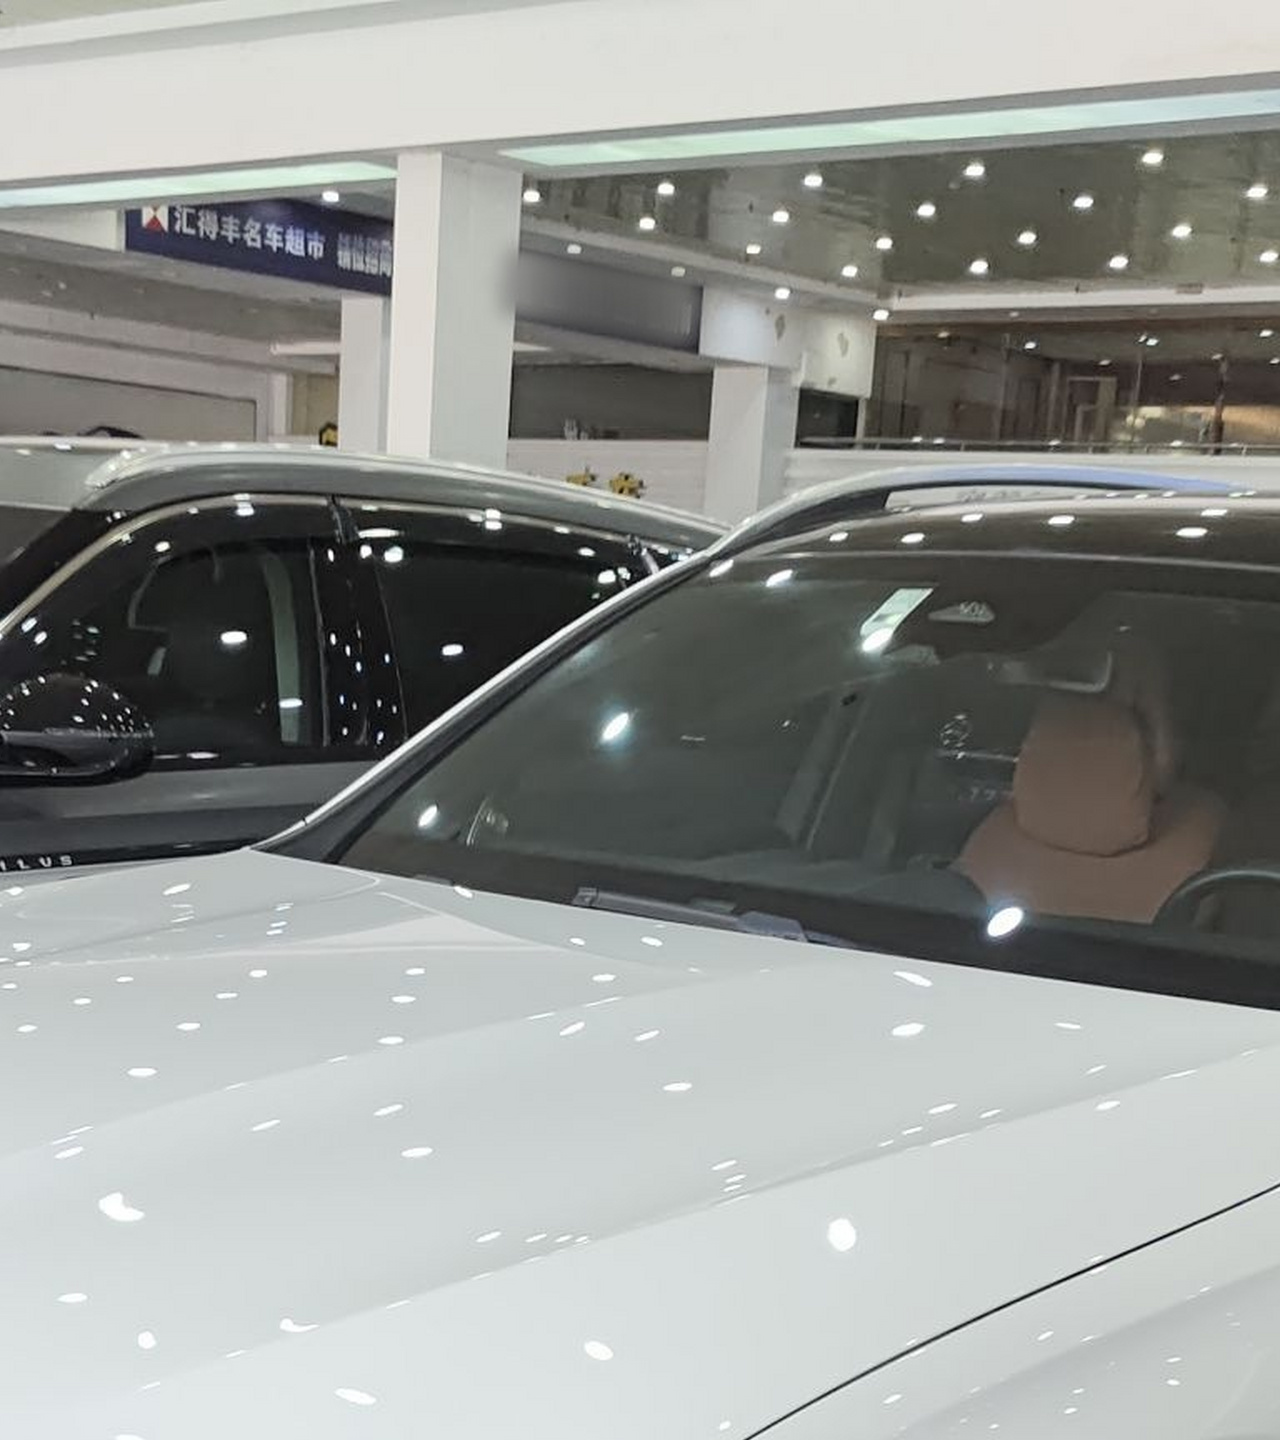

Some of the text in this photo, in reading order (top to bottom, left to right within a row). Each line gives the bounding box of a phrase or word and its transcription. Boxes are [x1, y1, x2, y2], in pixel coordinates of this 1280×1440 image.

[174, 204, 326, 261] 汇得丰名车超市
